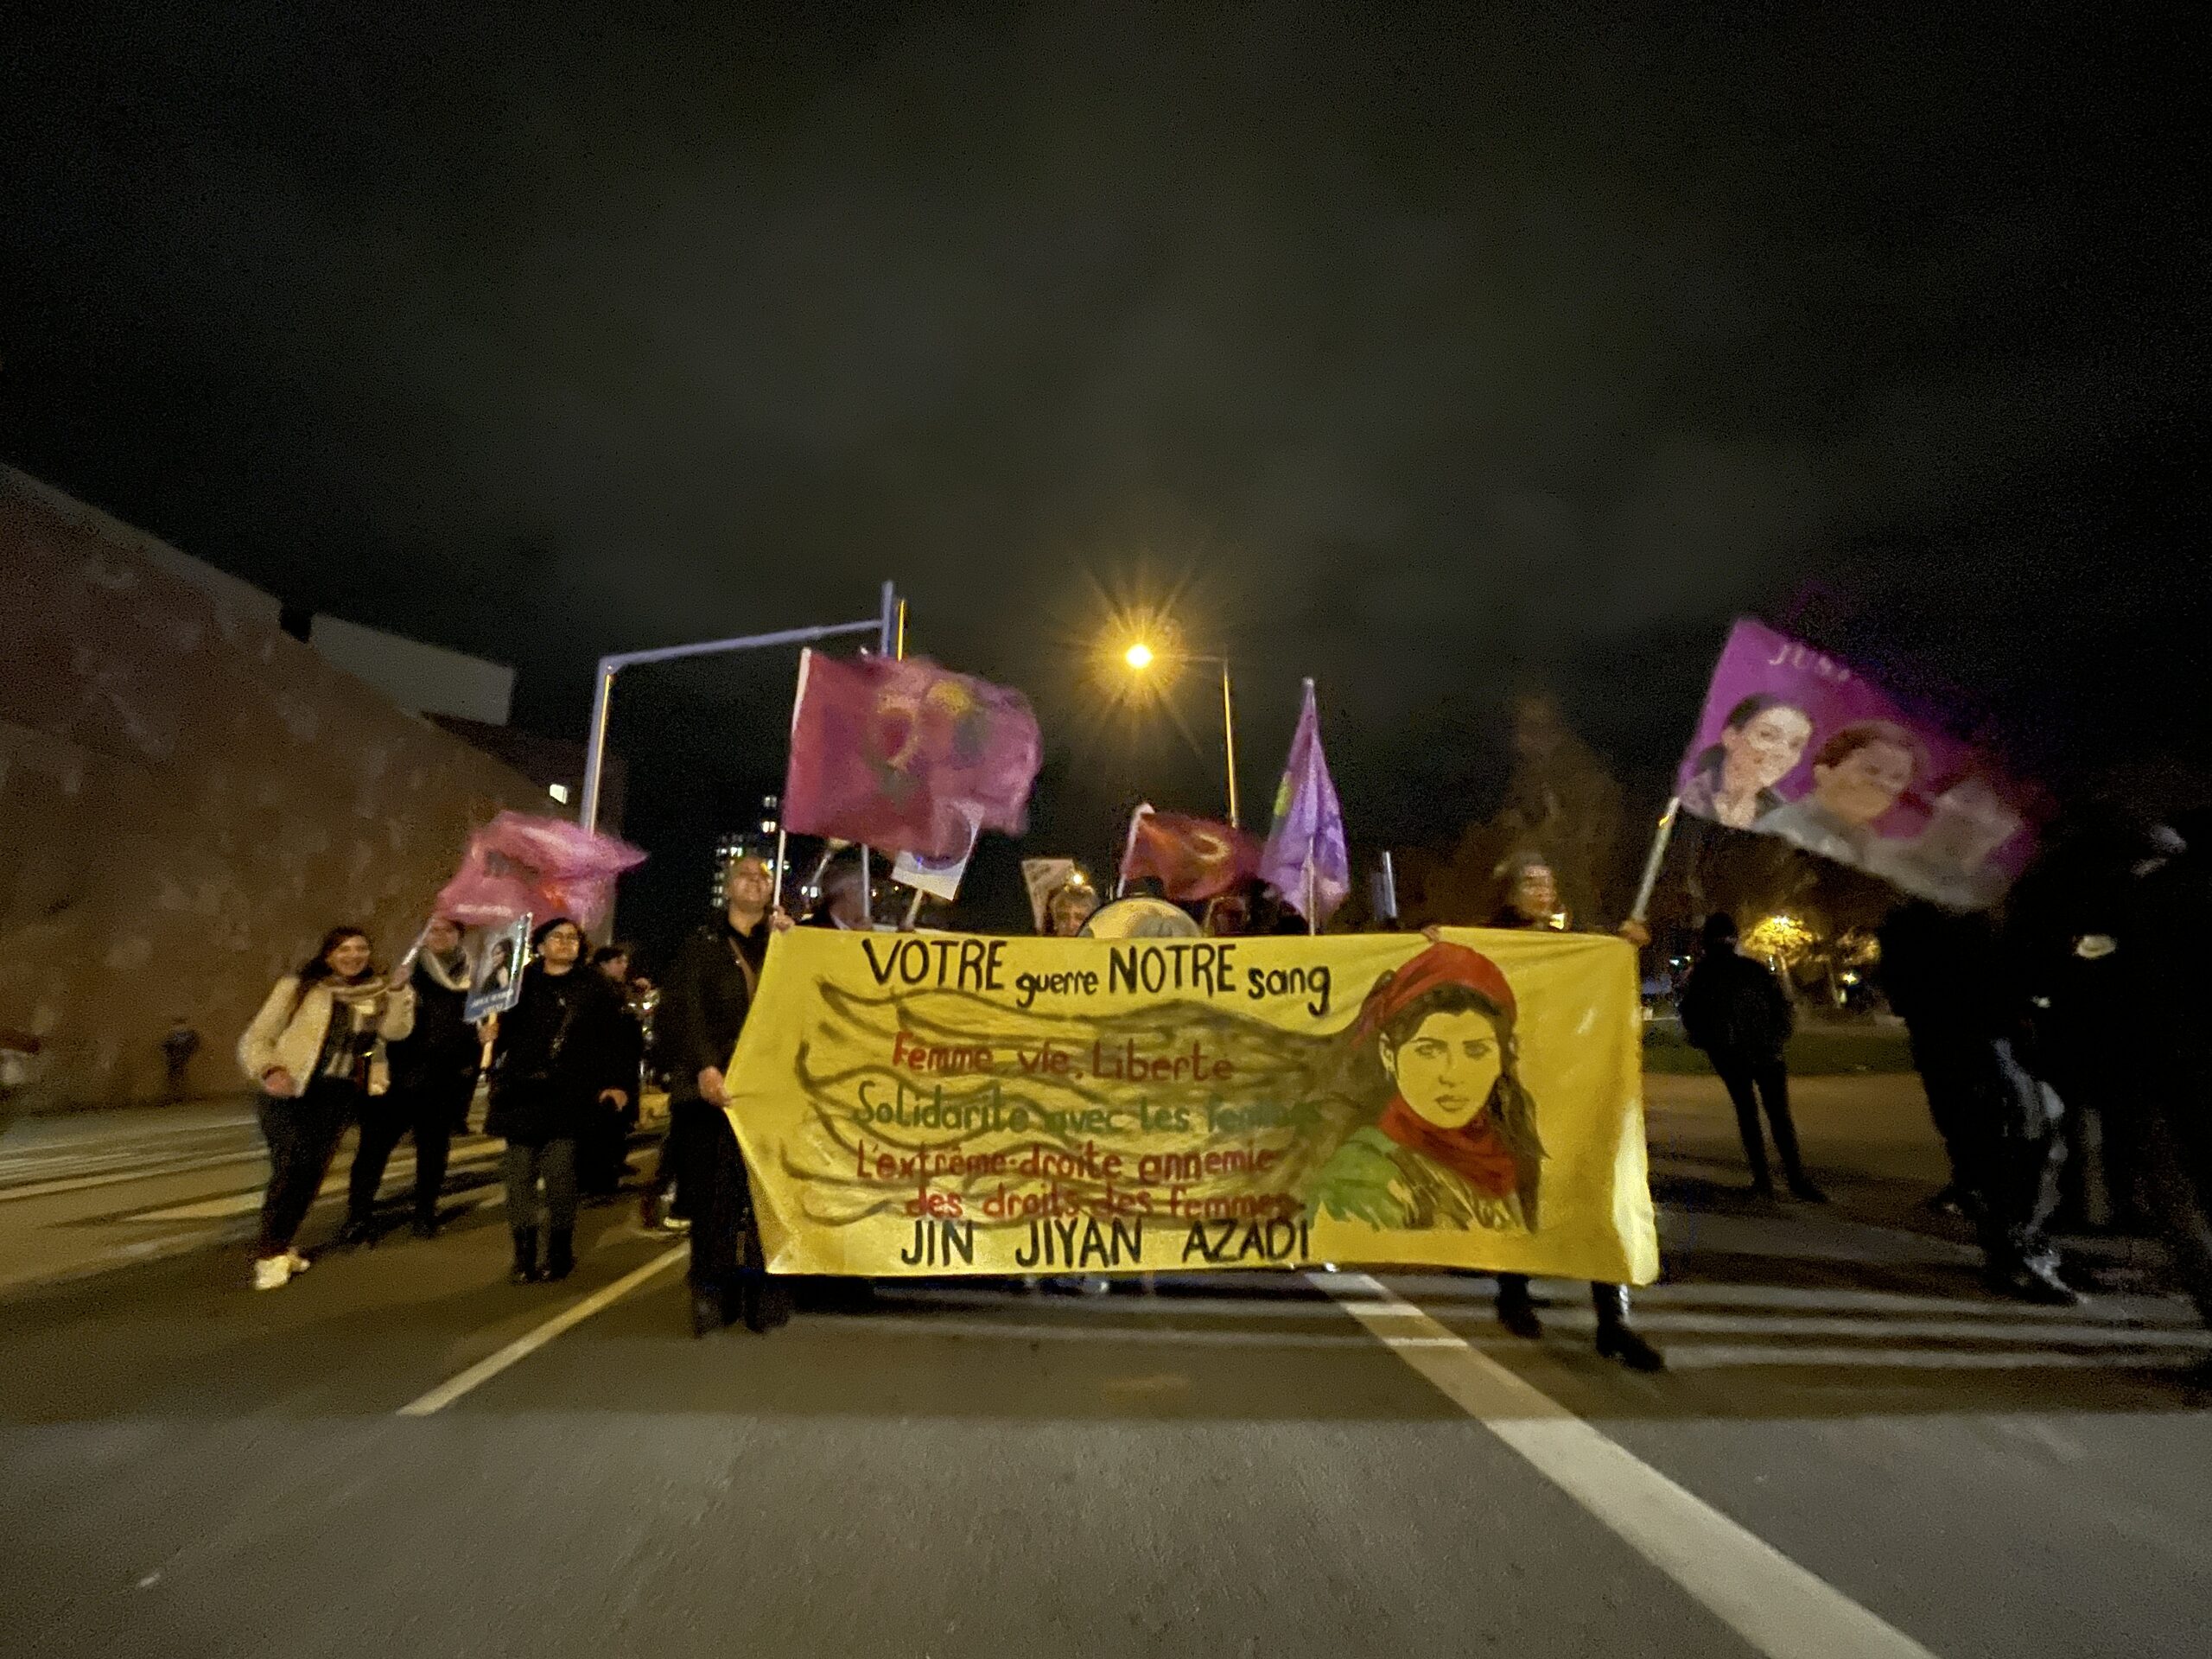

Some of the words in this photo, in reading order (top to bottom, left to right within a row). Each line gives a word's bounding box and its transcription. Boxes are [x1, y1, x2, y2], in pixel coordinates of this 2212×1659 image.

[861, 938, 1007, 991] VOTRE
[1015, 970, 1099, 1009] guerre
[1109, 944, 1236, 997] NOTRE
[1248, 965, 1331, 1017] sang
[893, 1031, 994, 1073] Femme
[905, 1182, 963, 1218] des
[983, 1180, 1081, 1218] droits
[901, 1219, 974, 1267] JIN
[1015, 1217, 1142, 1269] JIYAN
[1182, 1217, 1308, 1264] AZADI
